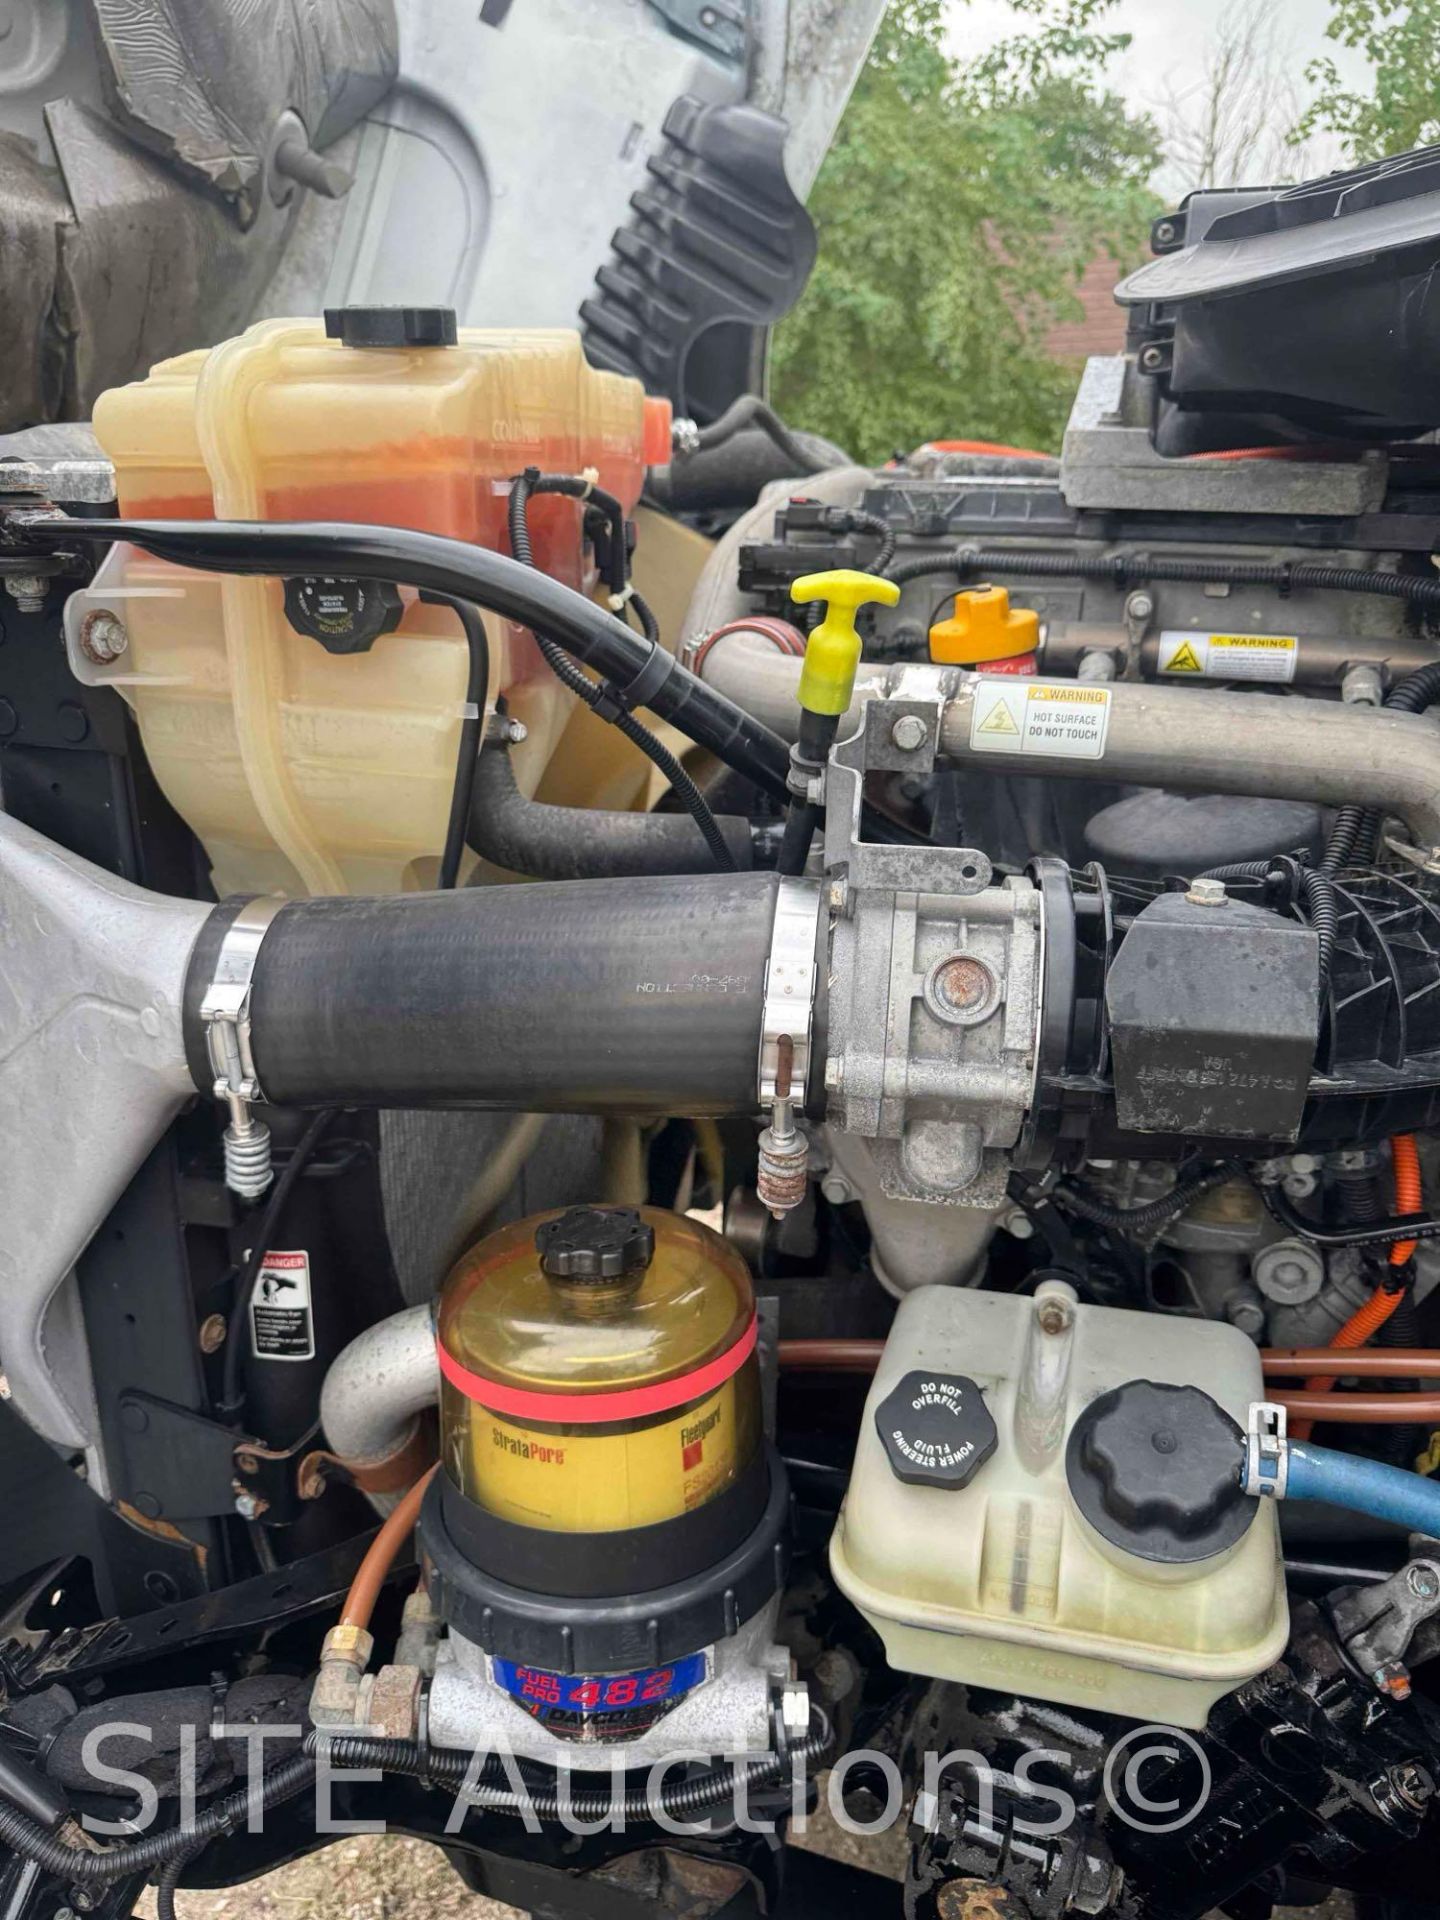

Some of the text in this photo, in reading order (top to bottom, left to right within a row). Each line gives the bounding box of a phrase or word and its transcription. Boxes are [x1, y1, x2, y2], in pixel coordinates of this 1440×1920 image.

[1229, 637, 1289, 648] WARNING
[1049, 689, 1103, 702] WARNING
[1033, 712, 1097, 726] HOT SURFACE
[1029, 726, 1098, 740] DO NOT TOUCH
[920, 1382, 962, 1398] DO NOT
[911, 1393, 963, 1416] OVERFILL
[681, 1403, 721, 1448] Fleetguard
[492, 1427, 565, 1466] StrataPore
[892, 1430, 975, 1468] POWER STEERING
[913, 1439, 951, 1456] FLUID
[516, 1667, 561, 1691] FUEL
[522, 1668, 674, 1708] PRO 482
